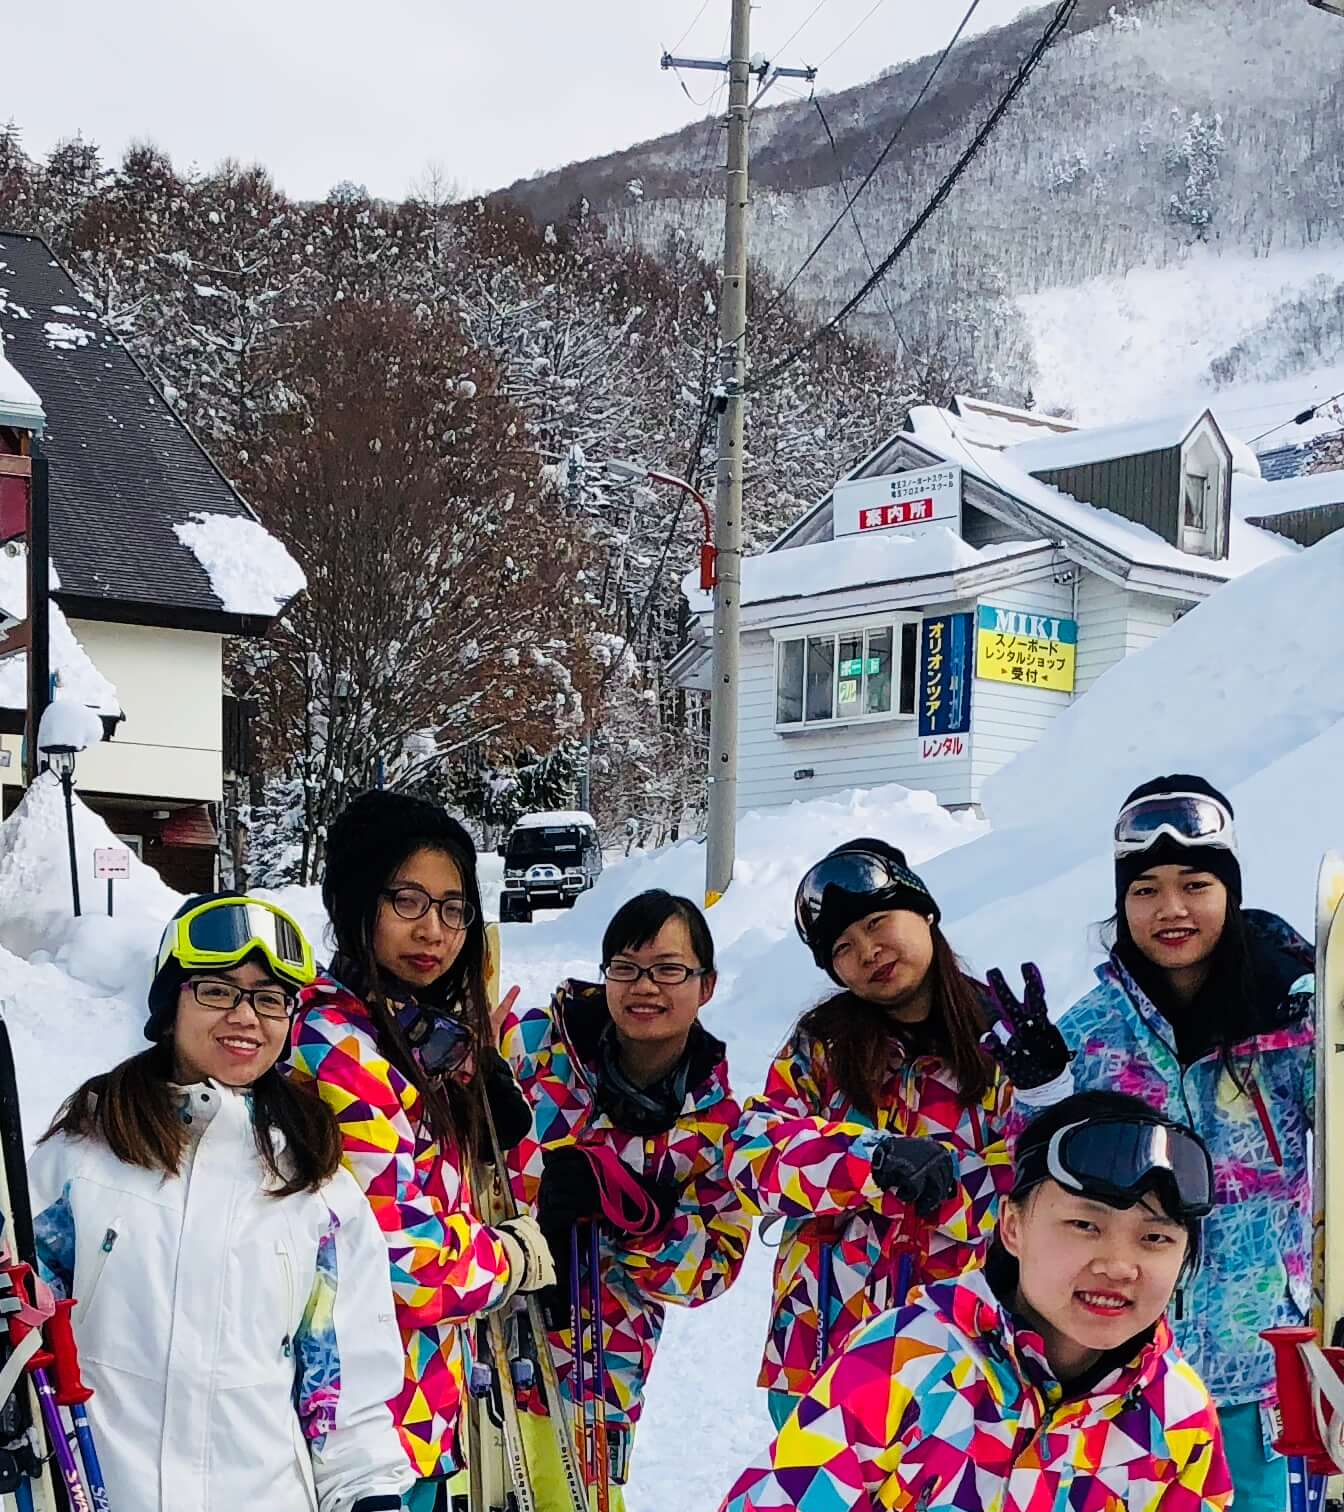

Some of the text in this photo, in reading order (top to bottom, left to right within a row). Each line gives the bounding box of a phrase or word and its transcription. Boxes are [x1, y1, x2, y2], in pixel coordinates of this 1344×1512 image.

[866, 501, 926, 527] 案内所
[995, 609, 1060, 640] MIKI
[996, 634, 1058, 656] スノーボード
[986, 646, 1066, 671] レンタルショップ
[926, 622, 944, 731] オリオンツアー
[1011, 667, 1038, 683] 受付
[923, 737, 962, 759] レンタル
